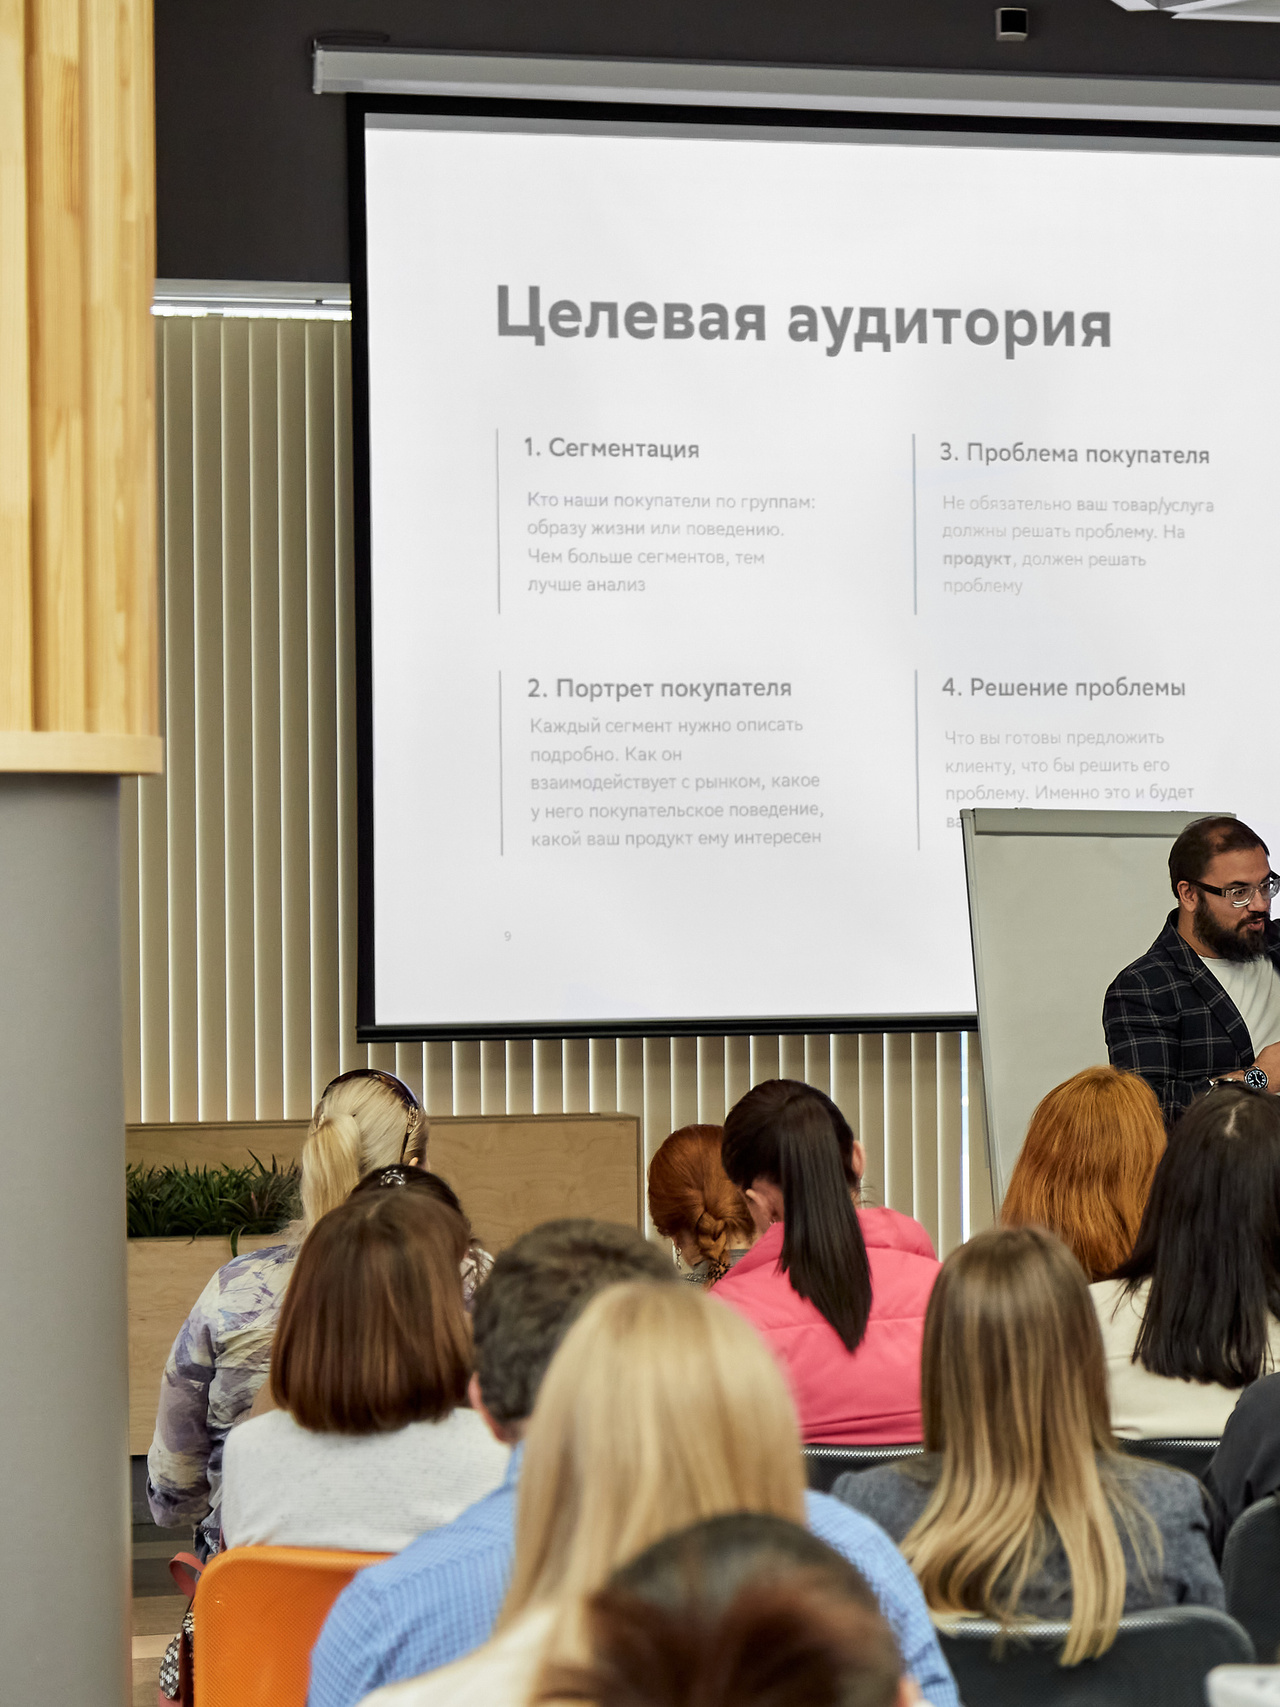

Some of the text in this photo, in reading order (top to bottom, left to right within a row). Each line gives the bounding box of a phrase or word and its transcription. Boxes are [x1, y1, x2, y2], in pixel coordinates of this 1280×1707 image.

[497, 284, 1111, 359] Целевая аудитория
[524, 436, 700, 461] 1. Сегментация
[940, 441, 1210, 468] 3. Проблема покупателя
[527, 491, 816, 512] Кто наши покупатели по группам:
[942, 493, 1215, 516] Не обязательно ваш товар/услуга
[526, 517, 785, 538] образу жизни или поведению.
[941, 522, 1186, 542] должны решать проблему. На
[527, 546, 766, 566] Чем больше сегментов, тем
[942, 553, 1147, 569] продукт, должен решать
[527, 578, 646, 595] лучше анализ
[942, 576, 1024, 596] проблему
[527, 677, 792, 702] 2. Портрет покупателя
[941, 675, 1186, 701] 4. Решение проблемы
[530, 716, 804, 736] Каждый сегмент нужно описать
[944, 729, 1166, 747] Что вы готовы предложить
[530, 744, 683, 765] подробно. Как он
[944, 756, 1171, 776] клиенту, что бы решить его
[530, 773, 821, 792] взаимодействует с рынком, какое
[945, 782, 1195, 803] проблему. Именно это и будет
[530, 803, 825, 822] у него покупательское поведение,
[531, 829, 822, 849] какой ваш продукт ему интересен
